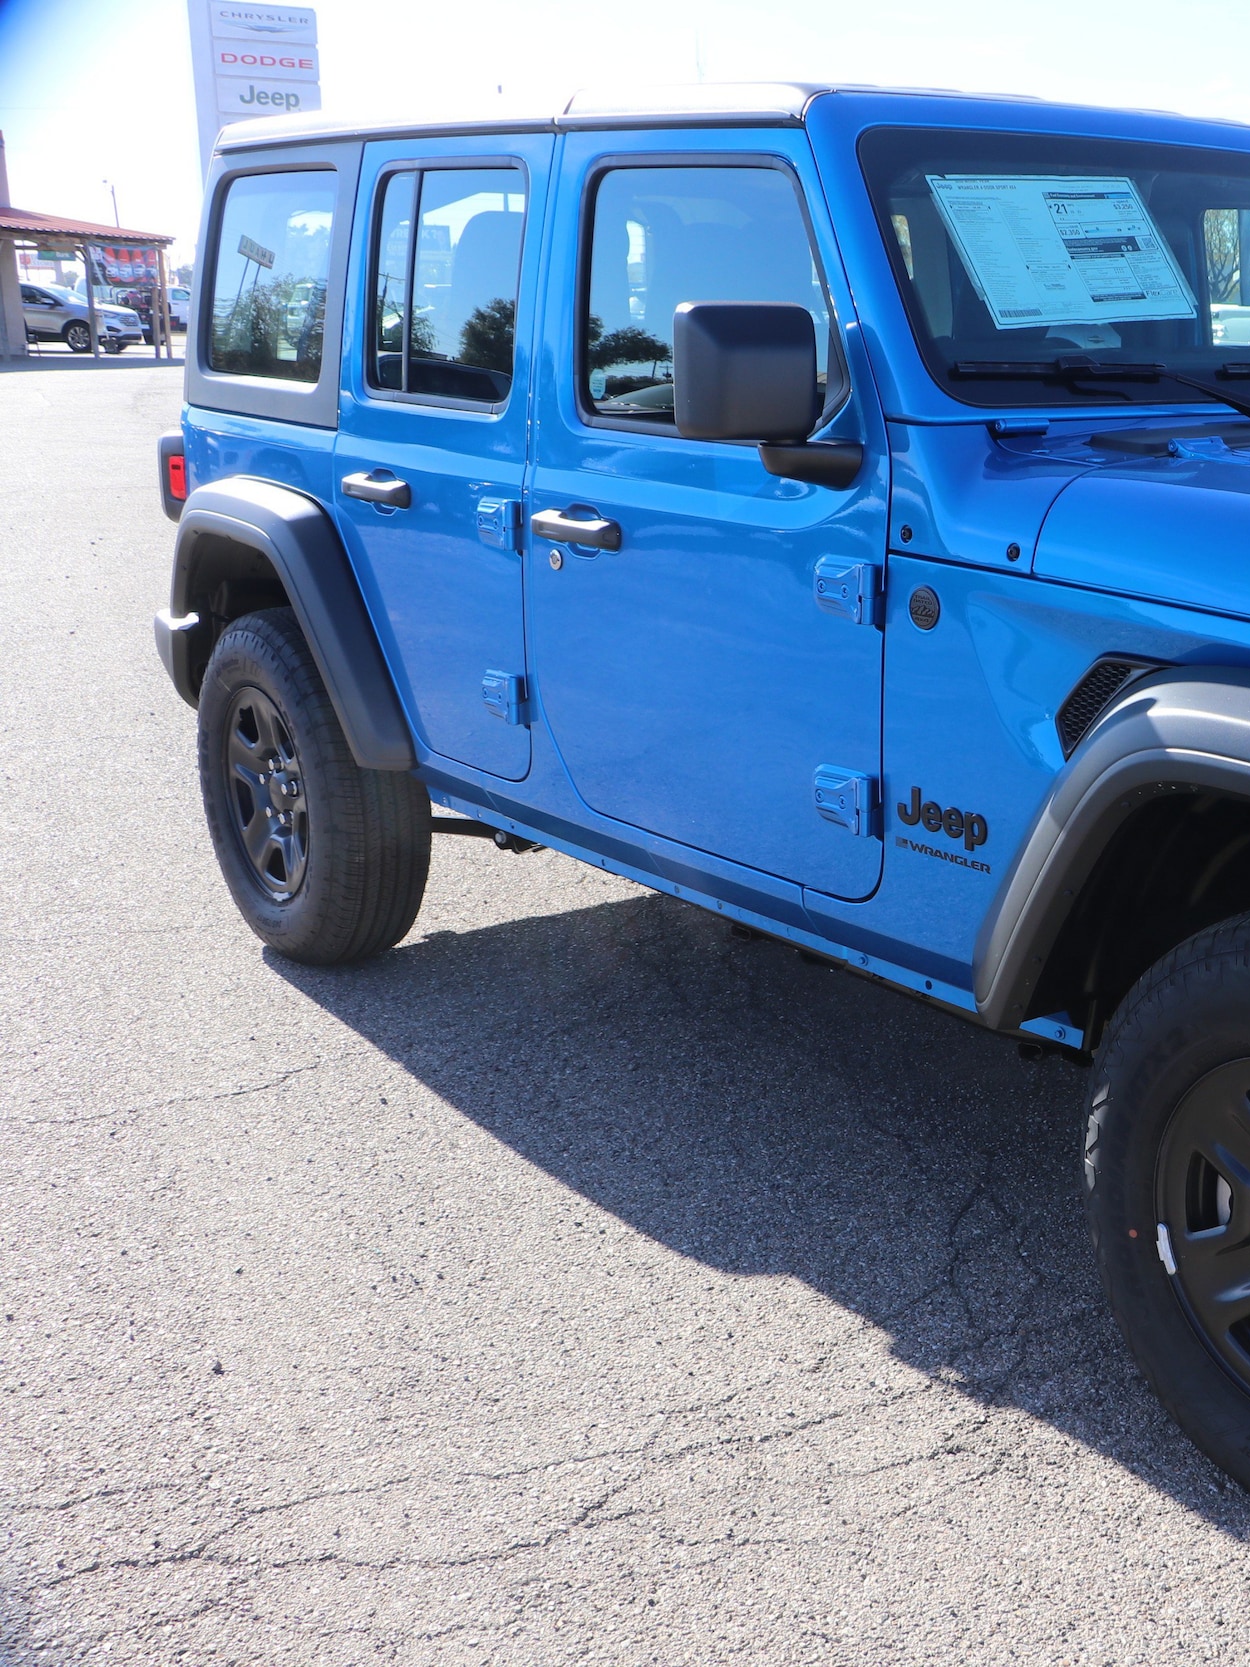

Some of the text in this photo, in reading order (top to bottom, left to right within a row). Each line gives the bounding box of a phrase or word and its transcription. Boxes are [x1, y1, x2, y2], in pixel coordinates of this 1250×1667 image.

[220, 10, 310, 25] CHRYSLER
[220, 53, 314, 70] DODGE
[239, 85, 300, 111] Jeep
[1053, 203, 1068, 214] 21
[897, 785, 988, 851] Jeep
[909, 839, 992, 875] WRANGLER
